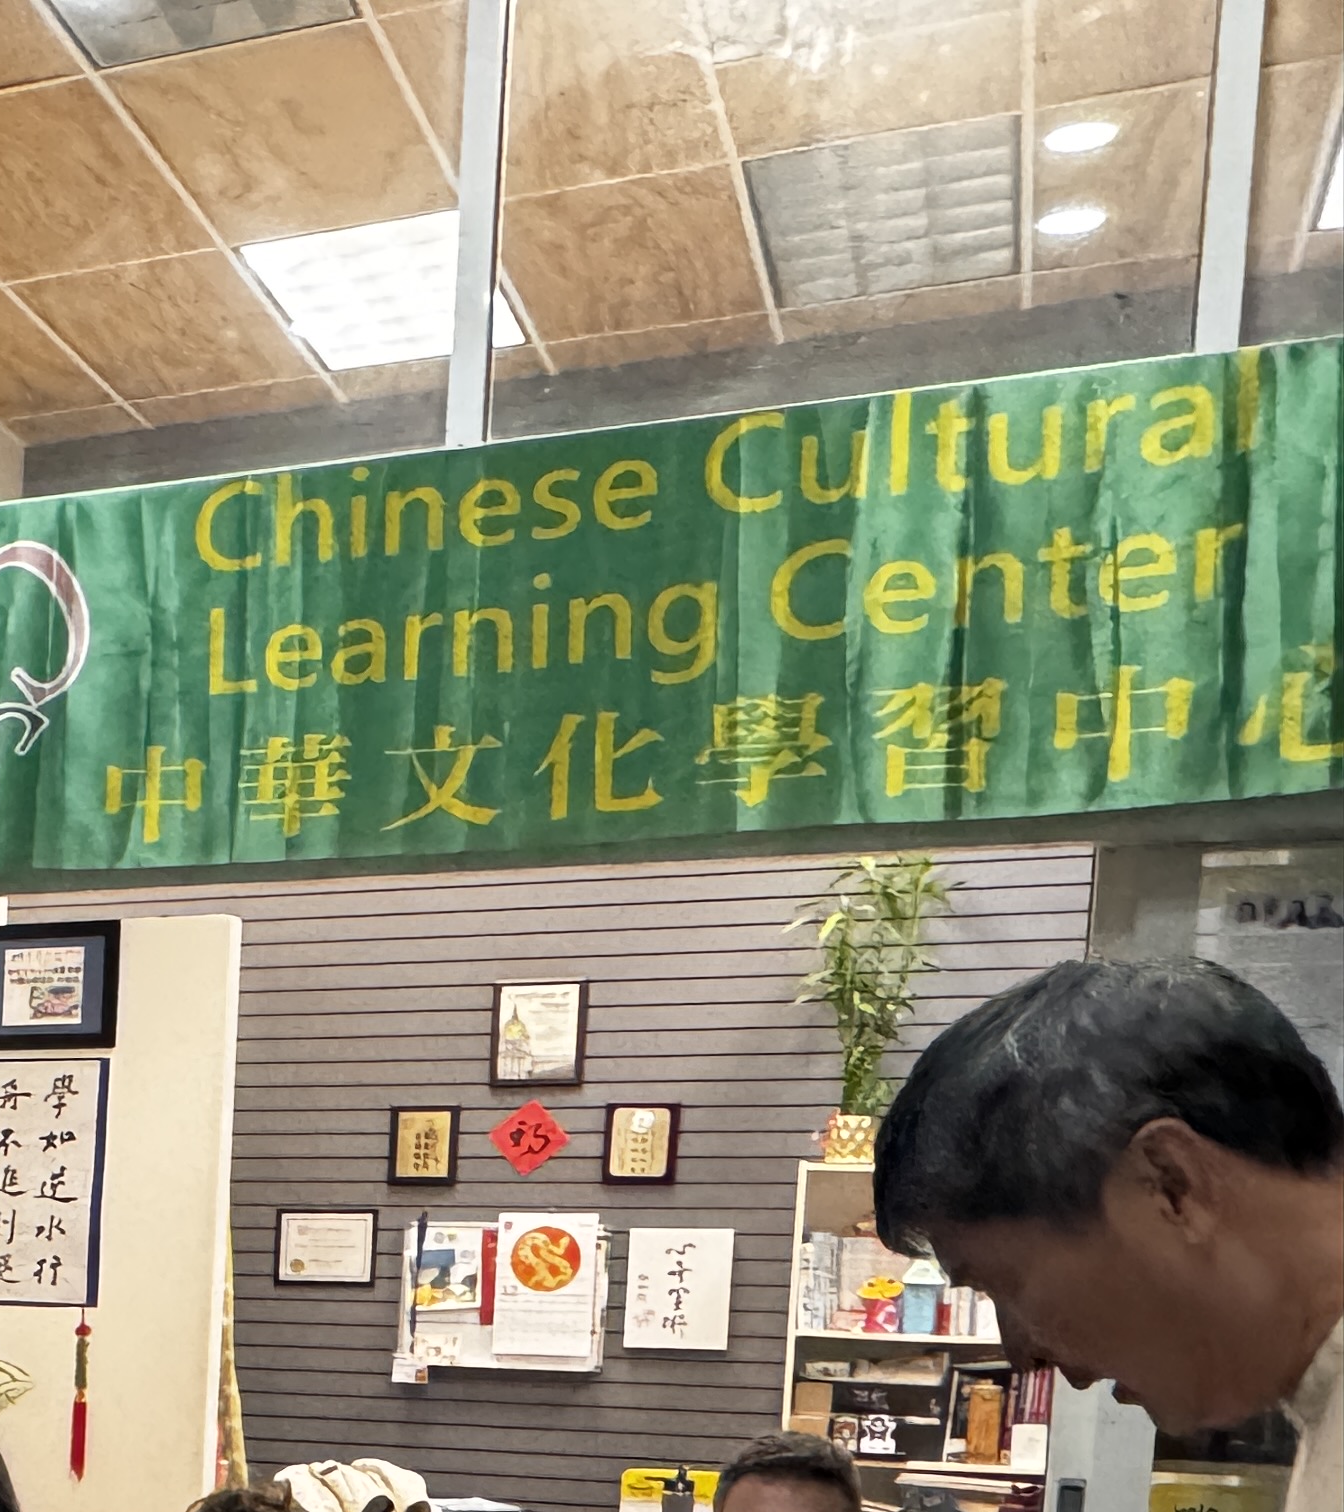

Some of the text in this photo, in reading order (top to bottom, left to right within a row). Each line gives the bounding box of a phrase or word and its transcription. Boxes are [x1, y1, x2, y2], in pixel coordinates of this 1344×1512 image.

[195, 348, 1262, 572] Chinese Cultural
[209, 524, 1245, 697] Learning Center
[105, 644, 1344, 845] 中華文化學習中心
